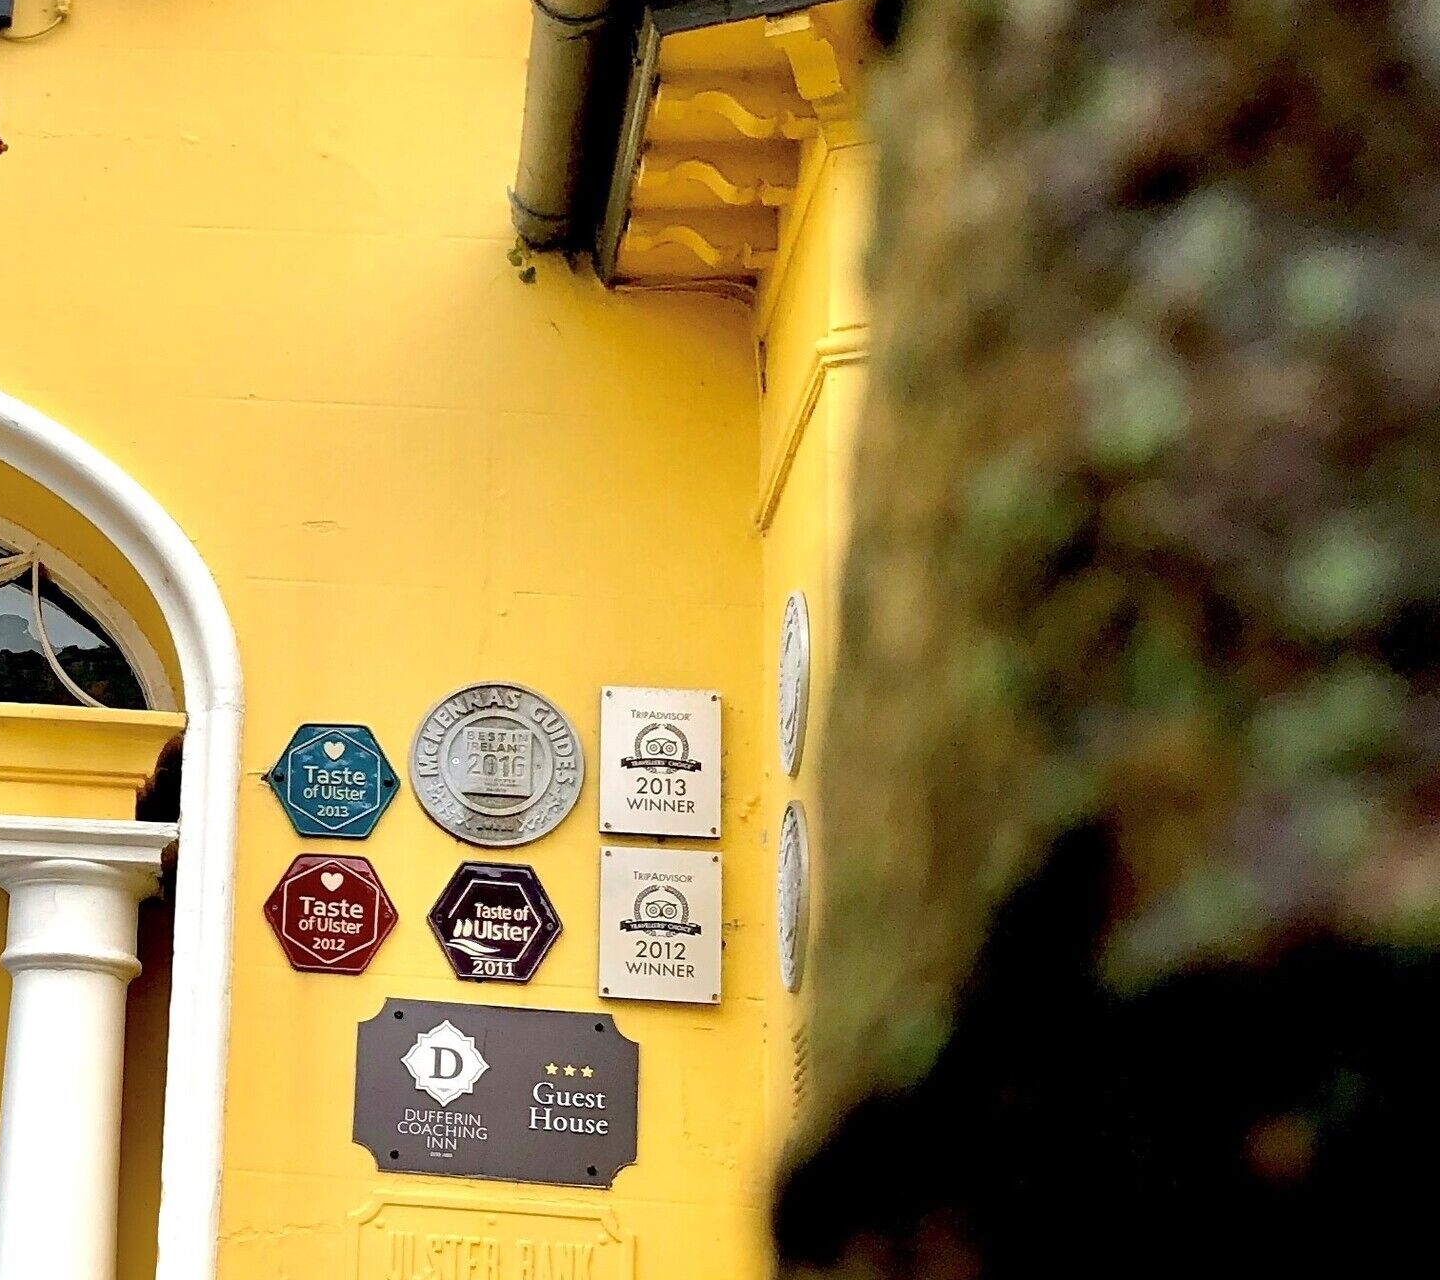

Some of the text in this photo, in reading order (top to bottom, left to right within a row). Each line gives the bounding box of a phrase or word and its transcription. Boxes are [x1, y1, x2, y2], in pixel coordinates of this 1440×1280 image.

[466, 730, 529, 742] BEST IN
[530, 703, 576, 785] GUIDES
[466, 741, 527, 753] IRELAND
[466, 753, 526, 778] 2016
[303, 765, 367, 786] Taste
[303, 784, 367, 801] of Ulster
[636, 776, 687, 796] 2013
[317, 805, 350, 818] 2013
[626, 797, 695, 814] WINNER
[298, 896, 364, 919] Taste
[474, 902, 530, 921] Taste of
[298, 916, 363, 935] of Ulster
[474, 919, 531, 942] Ulster
[312, 937, 346, 951] 2012
[635, 940, 686, 960] 2012
[472, 960, 515, 976] 2011
[625, 961, 695, 978] WINNER
[429, 1046, 464, 1080] D
[532, 1081, 607, 1109] Guest
[405, 1108, 481, 1127] DUFFERIN
[528, 1107, 609, 1135] House
[397, 1121, 488, 1140] COACHING
[426, 1135, 458, 1150] INN
